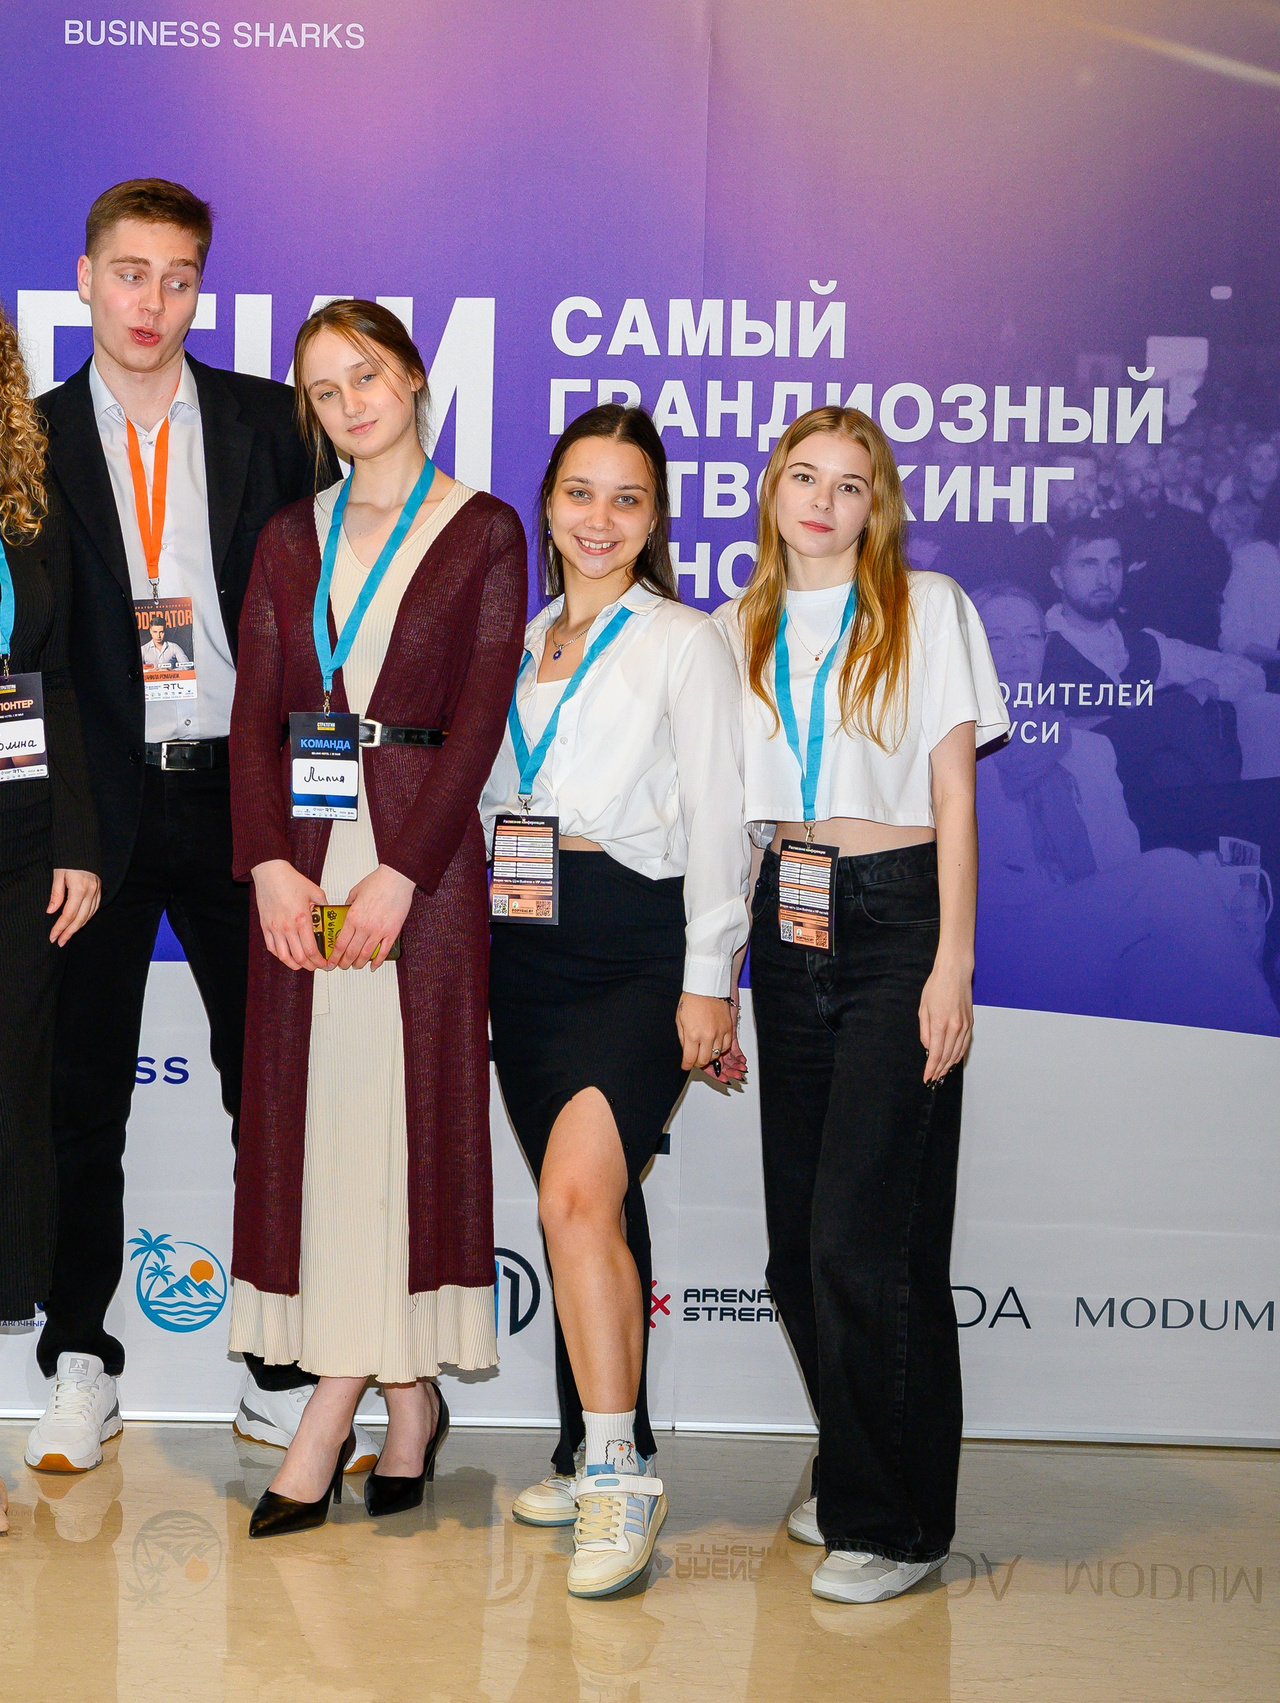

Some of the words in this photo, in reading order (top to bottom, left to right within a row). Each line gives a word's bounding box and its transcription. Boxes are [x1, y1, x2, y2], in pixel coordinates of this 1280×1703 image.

[64, 19, 221, 48] BUSINESS
[233, 21, 366, 50] SHARKS
[551, 279, 847, 359] САМЫЙ
[664, 460, 1075, 524] ТВКИНГ
[300, 739, 351, 751] КОМАНДА
[683, 1288, 774, 1304] ARENA
[683, 1307, 779, 1322] STREA
[1075, 1296, 1275, 1331] MODUM
